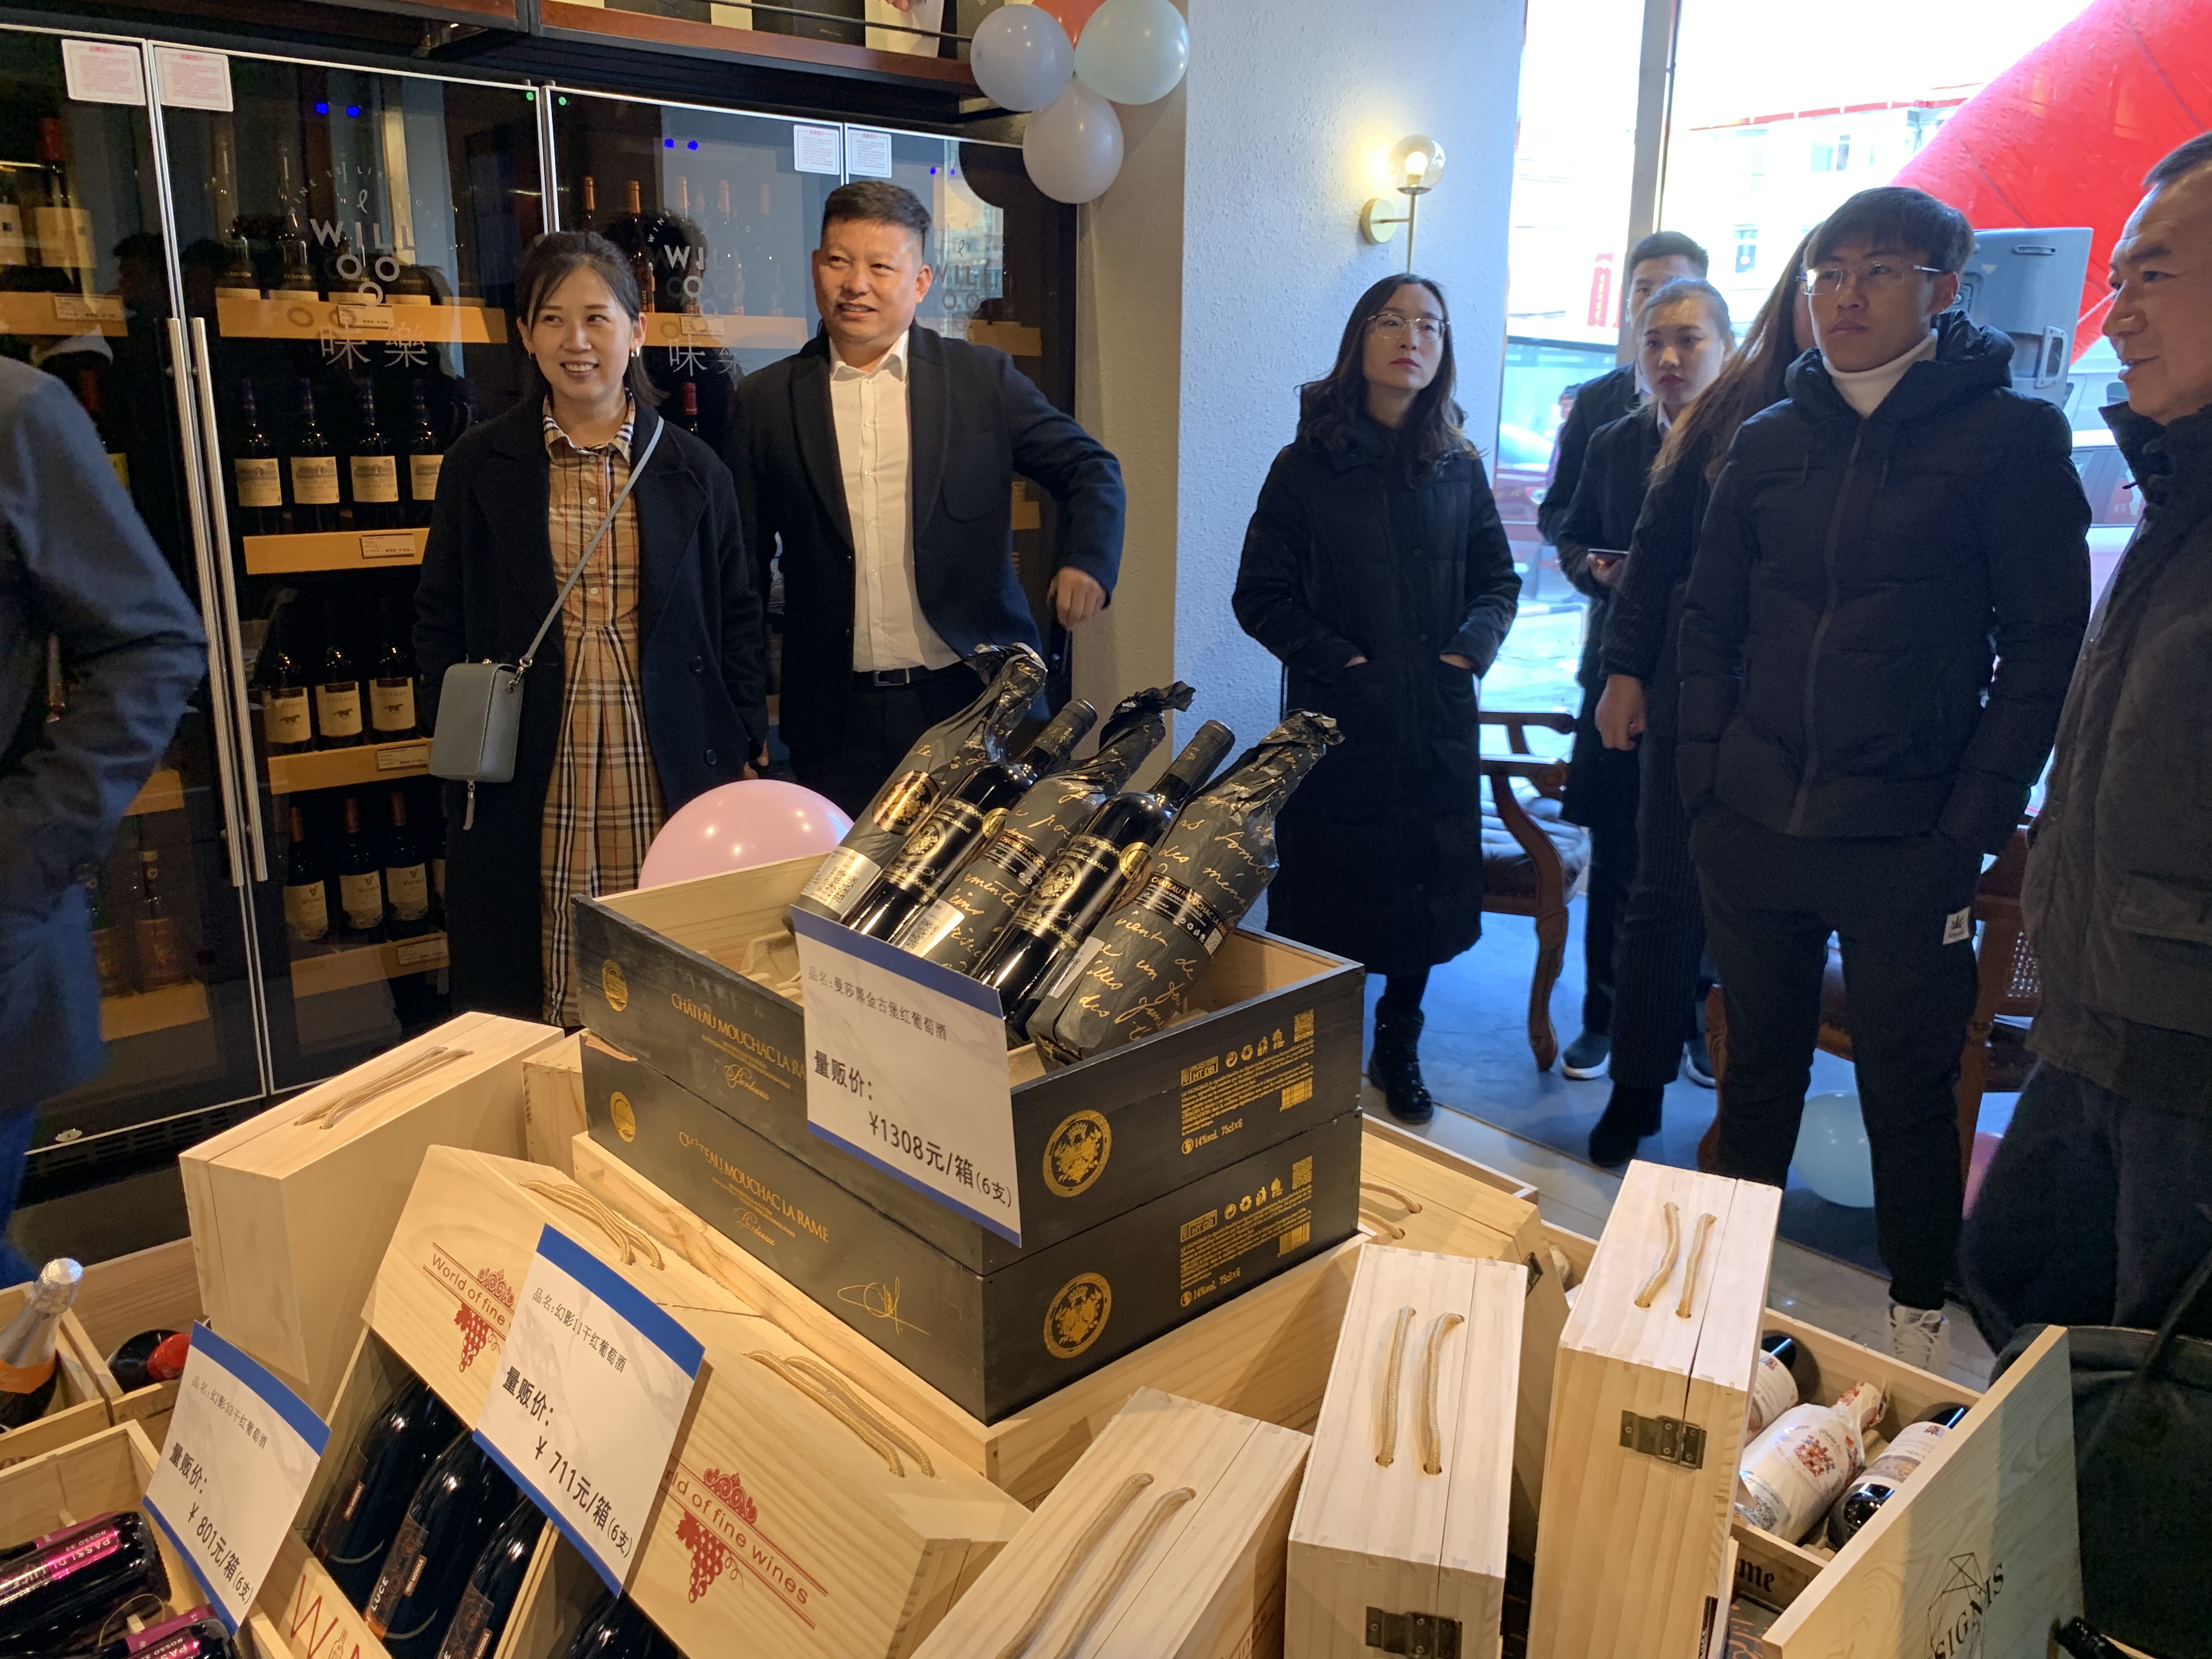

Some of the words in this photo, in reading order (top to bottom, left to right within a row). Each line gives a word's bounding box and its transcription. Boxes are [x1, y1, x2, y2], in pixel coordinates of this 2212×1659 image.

[319, 321, 428, 370] 味樂
[1151, 876, 1182, 894] CHATEAU
[718, 1019, 776, 1063] MOUCHAC
[776, 1051, 791, 1071] LA
[815, 1050, 872, 1101] 量贩价:
[724, 1161, 781, 1210] MOUCHAC
[783, 1199, 795, 1221] LA
[796, 1209, 830, 1243] RAME
[432, 1253, 467, 1291] World
[468, 1289, 483, 1304] of
[482, 1298, 505, 1326] fine
[503, 1365, 554, 1426] 量贩价:
[169, 1442, 207, 1494] 量贩价:
[72, 1536, 111, 1561] PASSI
[78, 1530, 106, 1545] ROSSO
[665, 1469, 690, 1495] rld
[692, 1493, 712, 1514] of
[713, 1508, 747, 1548] fine
[752, 1544, 808, 1604] wines
[371, 1576, 389, 1612] LUCE
[411, 1557, 425, 1583] MOSOLE
[154, 1637, 183, 1656] ROSSO
[476, 1632, 490, 1657] MOSOLE
